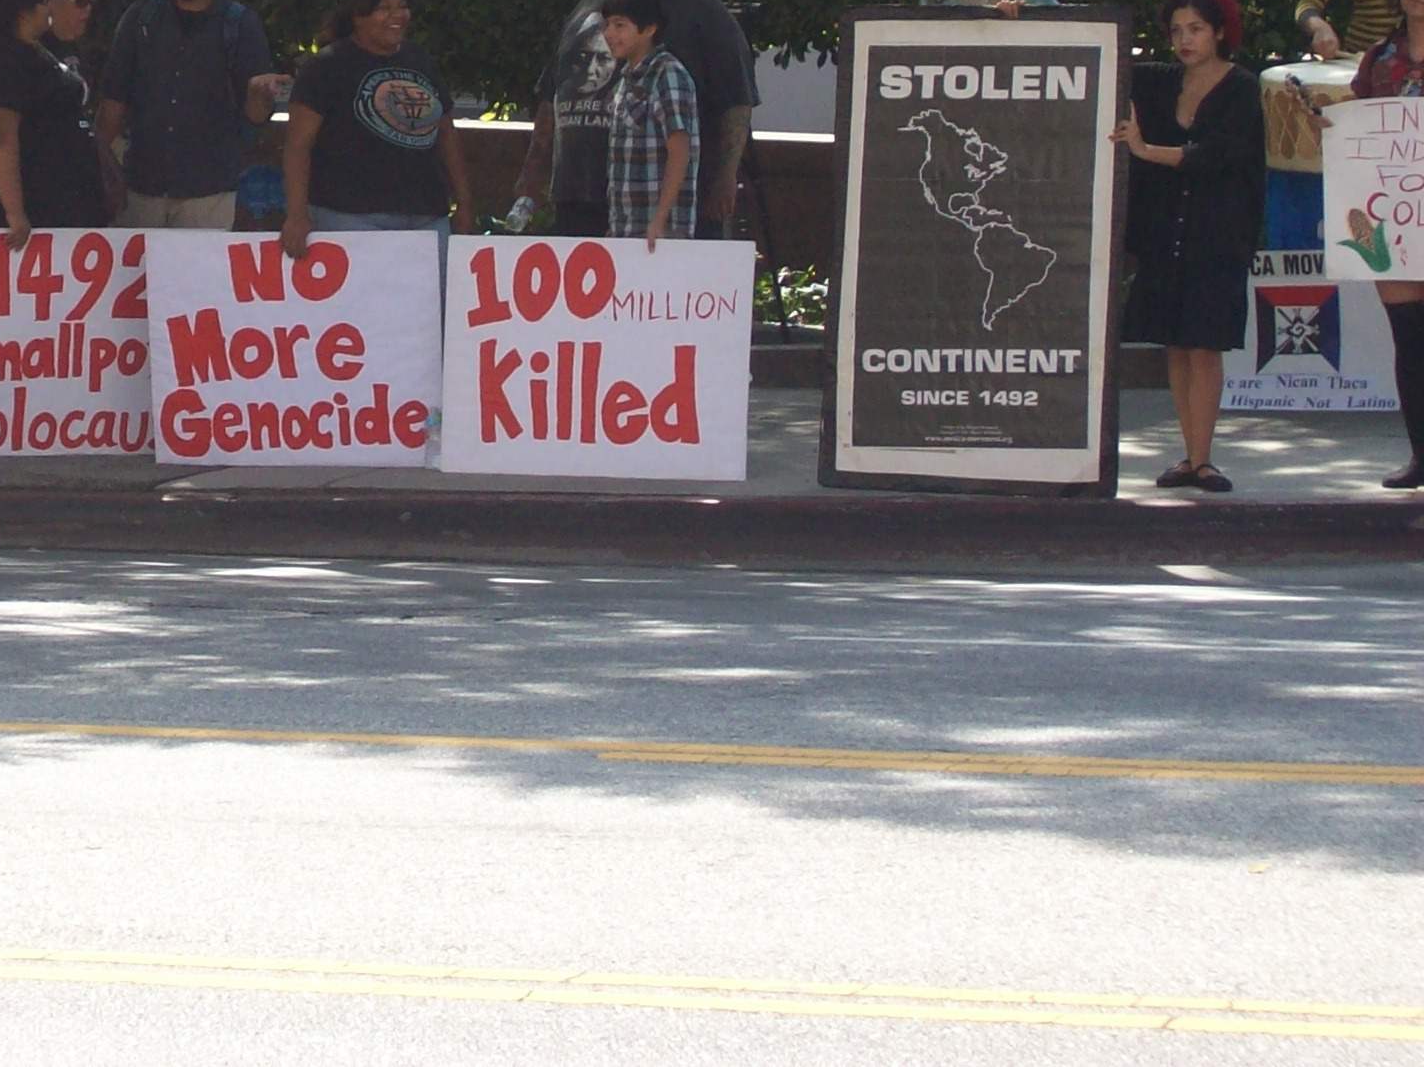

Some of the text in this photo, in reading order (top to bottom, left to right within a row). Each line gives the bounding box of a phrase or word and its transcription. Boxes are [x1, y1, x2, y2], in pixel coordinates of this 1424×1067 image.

[880, 65, 1086, 101] STOLEN
[228, 240, 349, 302] NO
[1250, 254, 1275, 276] CA
[467, 241, 737, 327] 100 MILLION
[167, 309, 366, 386] More
[862, 349, 1082, 374] CONTINENT
[479, 338, 700, 445] Killed
[901, 389, 1038, 407] SINCE 1492
[1239, 378, 1263, 389] are
[1277, 374, 1318, 389] Nican
[1328, 376, 1368, 390] Tlaca
[1231, 394, 1396, 409] Hispanic Not Latino
[160, 384, 429, 458] Genocide
